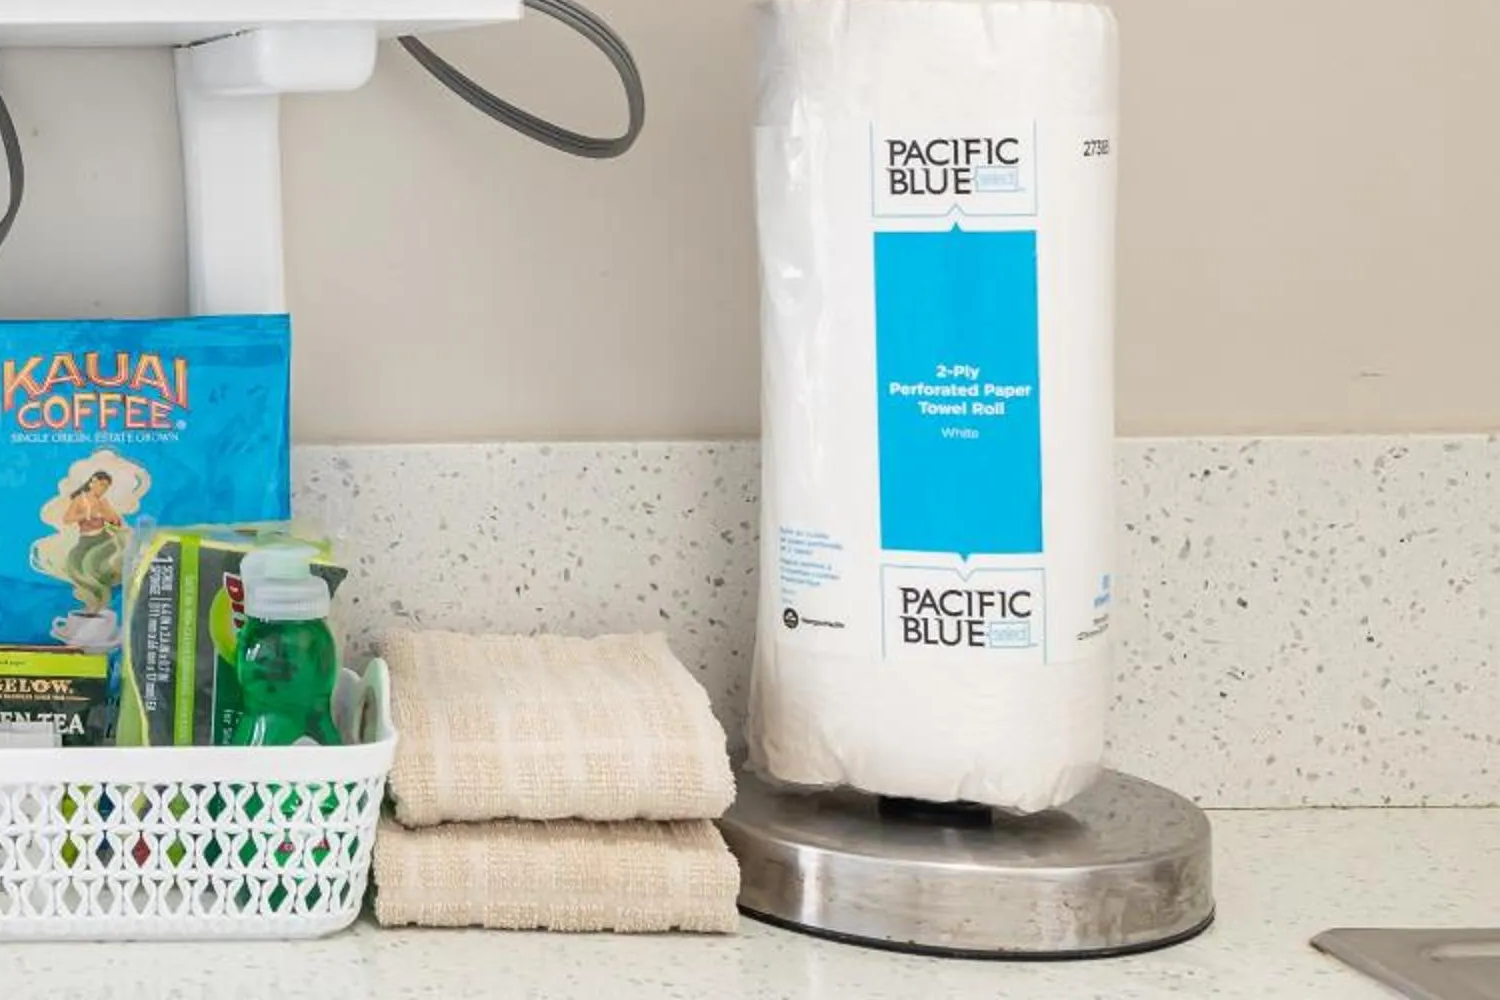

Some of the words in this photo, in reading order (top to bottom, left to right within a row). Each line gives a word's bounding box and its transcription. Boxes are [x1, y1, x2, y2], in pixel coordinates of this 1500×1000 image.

[885, 138, 1019, 166] PACIFIC
[886, 168, 972, 195] BLUE
[3, 351, 188, 411] KAUAI
[936, 364, 980, 380] 2-Ply
[889, 382, 979, 397] Perforated
[984, 383, 1032, 399] Paper
[17, 392, 174, 430] COFFEE
[918, 401, 967, 415] Towel
[972, 401, 1005, 416] Roll
[11, 432, 48, 443] SINGLE
[95, 431, 135, 443] ESTATE
[136, 431, 179, 442] GROWN
[941, 427, 980, 439] White
[898, 587, 1032, 618] PACIFIC
[900, 616, 985, 647] BLUE
